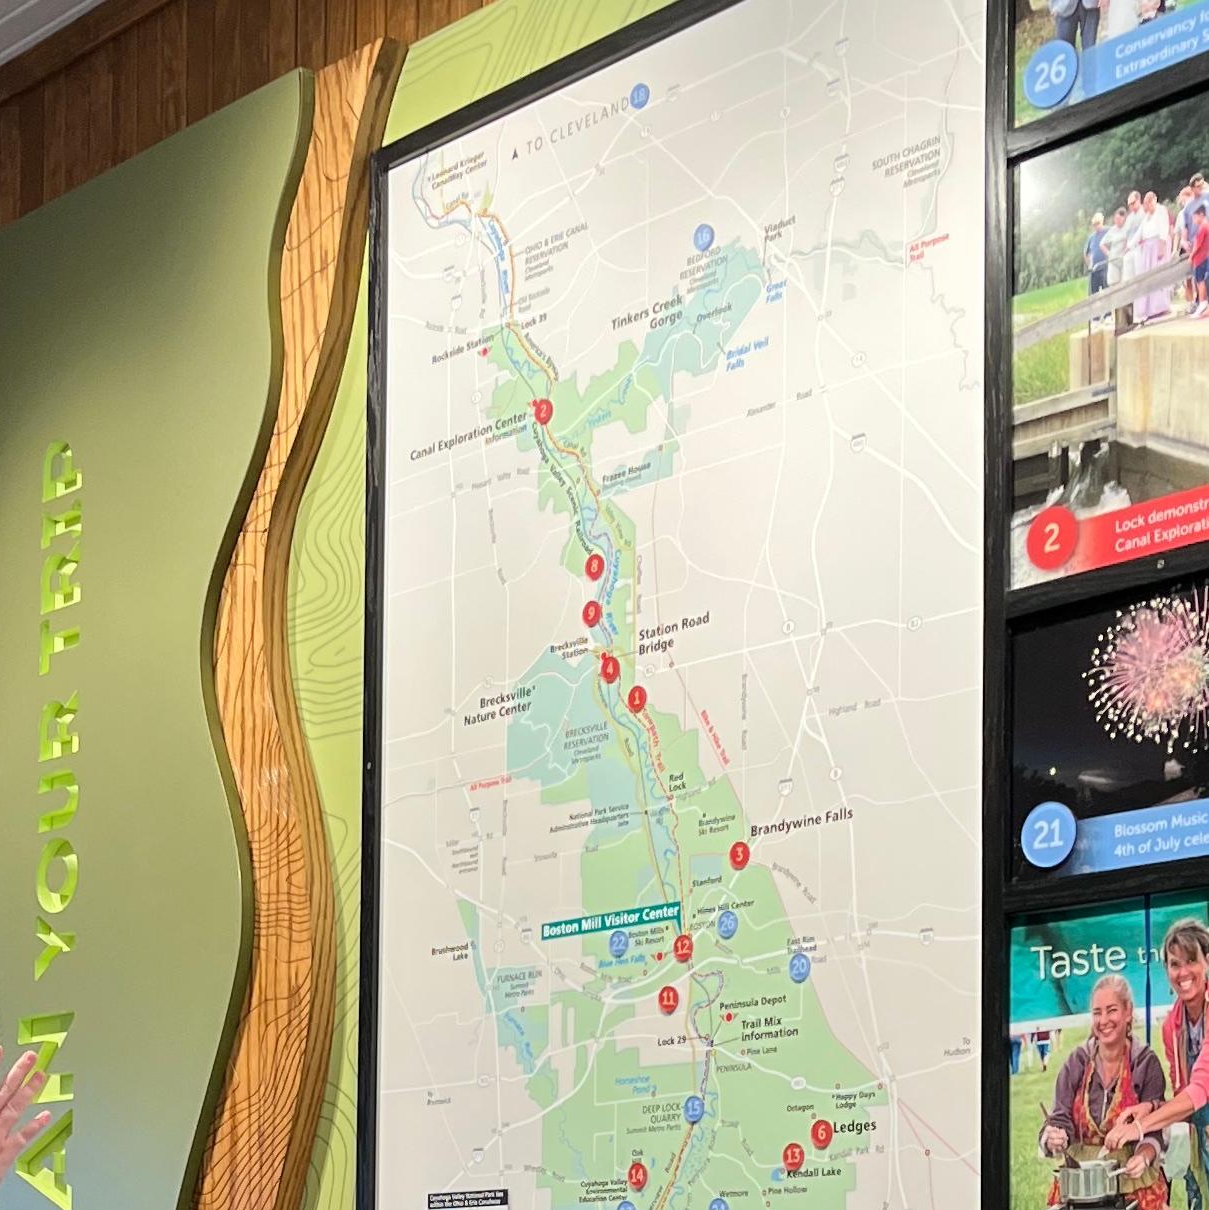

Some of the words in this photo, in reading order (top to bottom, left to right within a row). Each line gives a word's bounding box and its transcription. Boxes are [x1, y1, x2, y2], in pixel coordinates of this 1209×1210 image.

[1116, 14, 1197, 59] Conservancy
[1116, 35, 1198, 79] Extraordinary
[1034, 53, 1066, 92] 26
[527, 137, 543, 154] TO
[551, 97, 629, 143] CLEVELAND
[872, 151, 900, 170] SOUTH
[902, 136, 941, 159] CHAGRIN
[611, 307, 650, 330] Tinkers
[653, 294, 683, 315] Creek
[650, 310, 683, 330] Gorge
[697, 303, 732, 323] Overlook
[410, 447, 436, 461] Canal
[438, 424, 493, 455] Exploration
[496, 412, 527, 429] Center
[1115, 516, 1145, 533] Lock
[1148, 501, 1209, 524] demonstr
[1044, 523, 1061, 553] 2
[1115, 531, 1151, 553] Canal
[38, 442, 84, 677] TRIP
[639, 620, 678, 641] Station
[682, 612, 710, 631] Road
[639, 638, 675, 655] Bridge
[480, 687, 532, 709] Brecksville
[464, 707, 497, 726] Nature
[499, 701, 532, 718] Center
[669, 772, 684, 783] Red
[669, 783, 686, 792] Lock
[34, 688, 80, 982] YOUR
[750, 815, 822, 838] Brandywine
[825, 808, 854, 826] Falls
[1033, 818, 1063, 849] 21
[1114, 820, 1167, 838] Blossom
[1172, 813, 1207, 829] Music
[1114, 843, 1134, 857] 4th
[1139, 840, 1151, 854] of
[1154, 837, 1180, 852] July
[543, 923, 578, 938] Boston
[581, 917, 602, 931] Mill
[605, 911, 640, 927] Visitor
[643, 905, 679, 921] Center
[613, 938, 625, 951] 22
[677, 940, 689, 954] 12
[1030, 944, 1126, 980] Taste
[719, 998, 760, 1011] Peninsula
[762, 995, 787, 1008] Depot
[742, 1017, 762, 1030] Trail
[764, 1016, 783, 1027] Mix
[657, 1037, 674, 1048] Lock
[676, 1035, 686, 1045] 29
[833, 1120, 877, 1134] Ledges
[786, 1168, 820, 1179] Kendall
[822, 1167, 842, 1177] Lake
